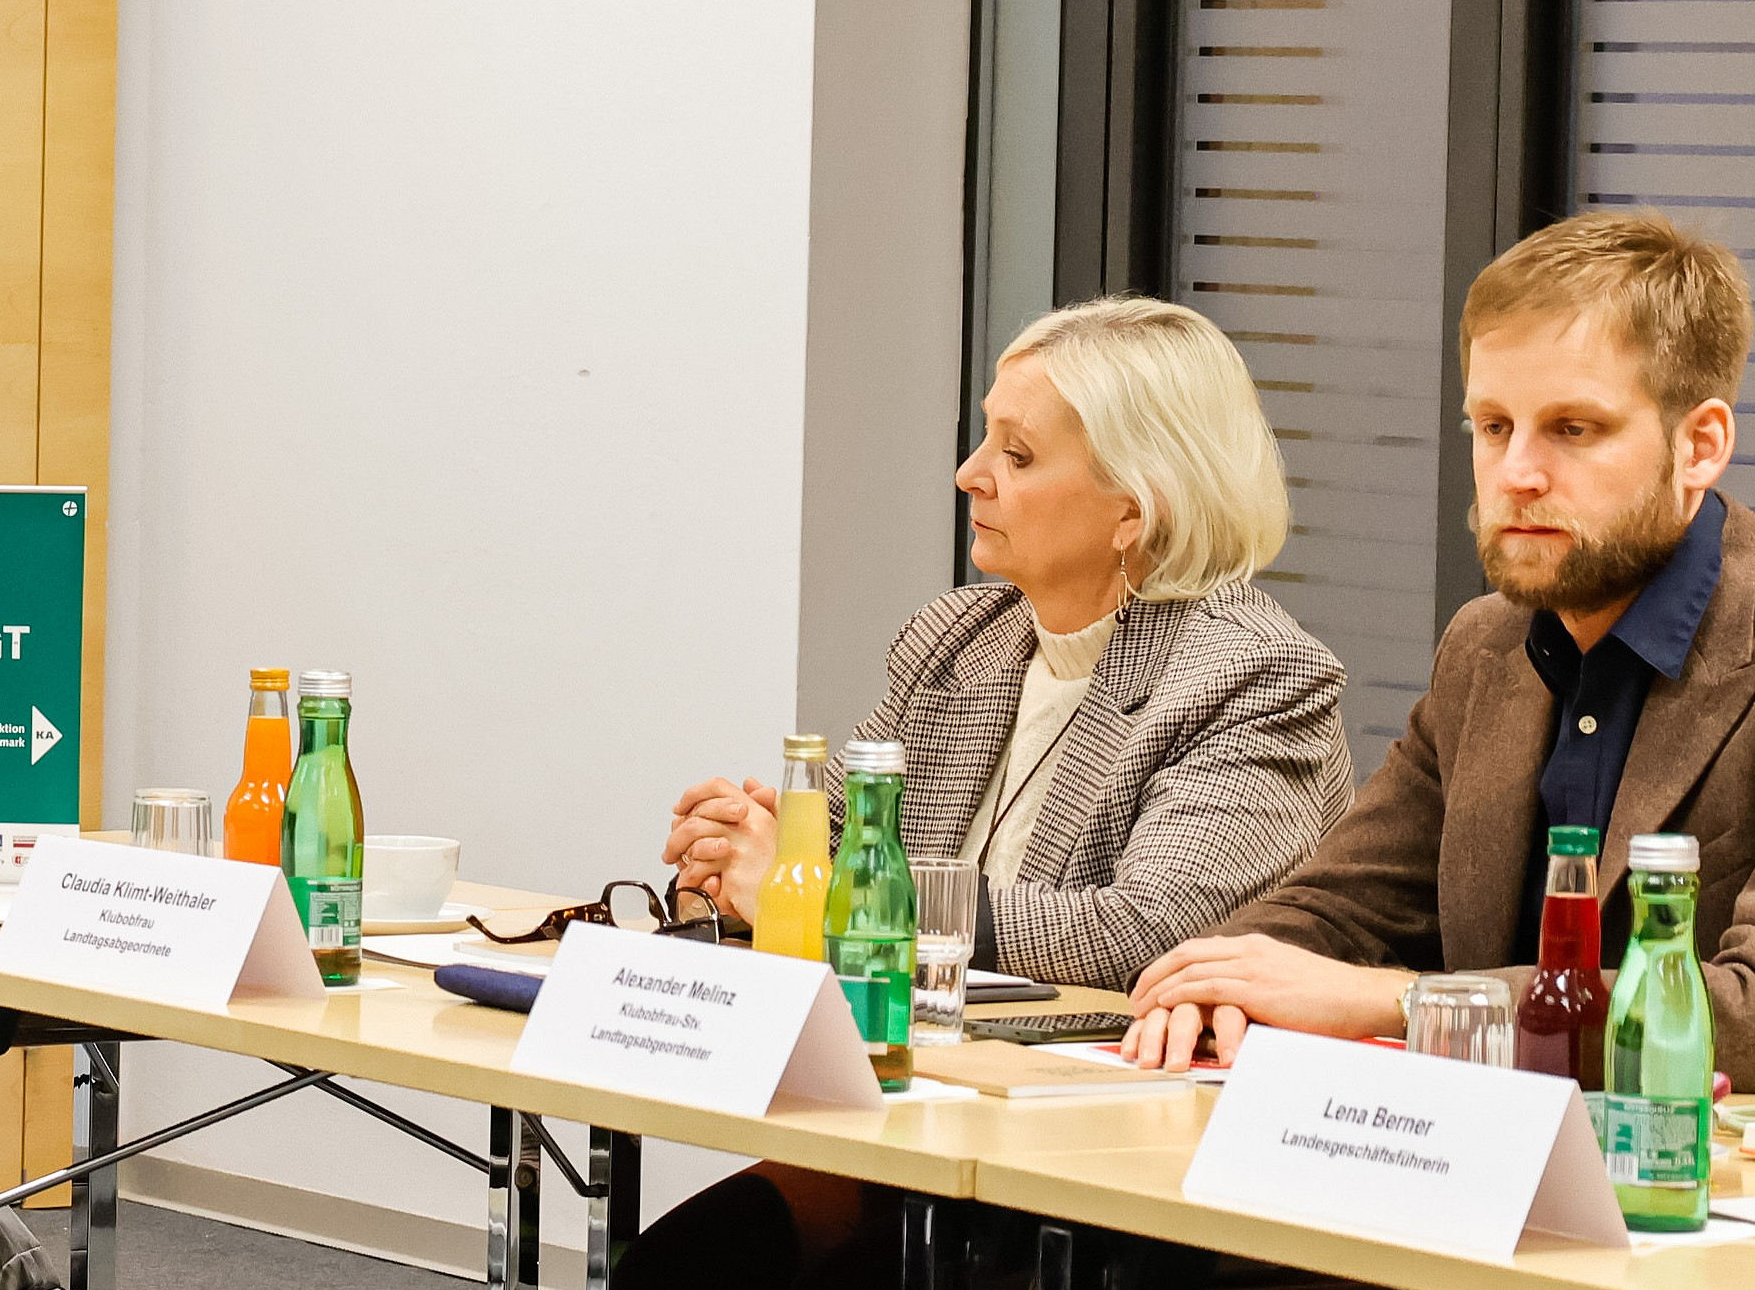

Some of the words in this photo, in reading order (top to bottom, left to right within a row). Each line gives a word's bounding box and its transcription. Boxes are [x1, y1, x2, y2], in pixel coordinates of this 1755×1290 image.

[36, 731, 54, 740] KA
[61, 872, 111, 895] Claudia
[112, 880, 217, 911] Klimt-Weithaler
[99, 909, 155, 929] Klubobfrau
[63, 928, 172, 958] Landtagsabgeordnete
[612, 967, 687, 996] Alexander
[688, 980, 737, 1007] Melinz
[590, 1025, 713, 1060] Landtagsabgeordneter
[1323, 1096, 1369, 1125] Lena
[1372, 1106, 1435, 1137] Berner
[1281, 1128, 1450, 1175] Landesgeschäftsführerin
